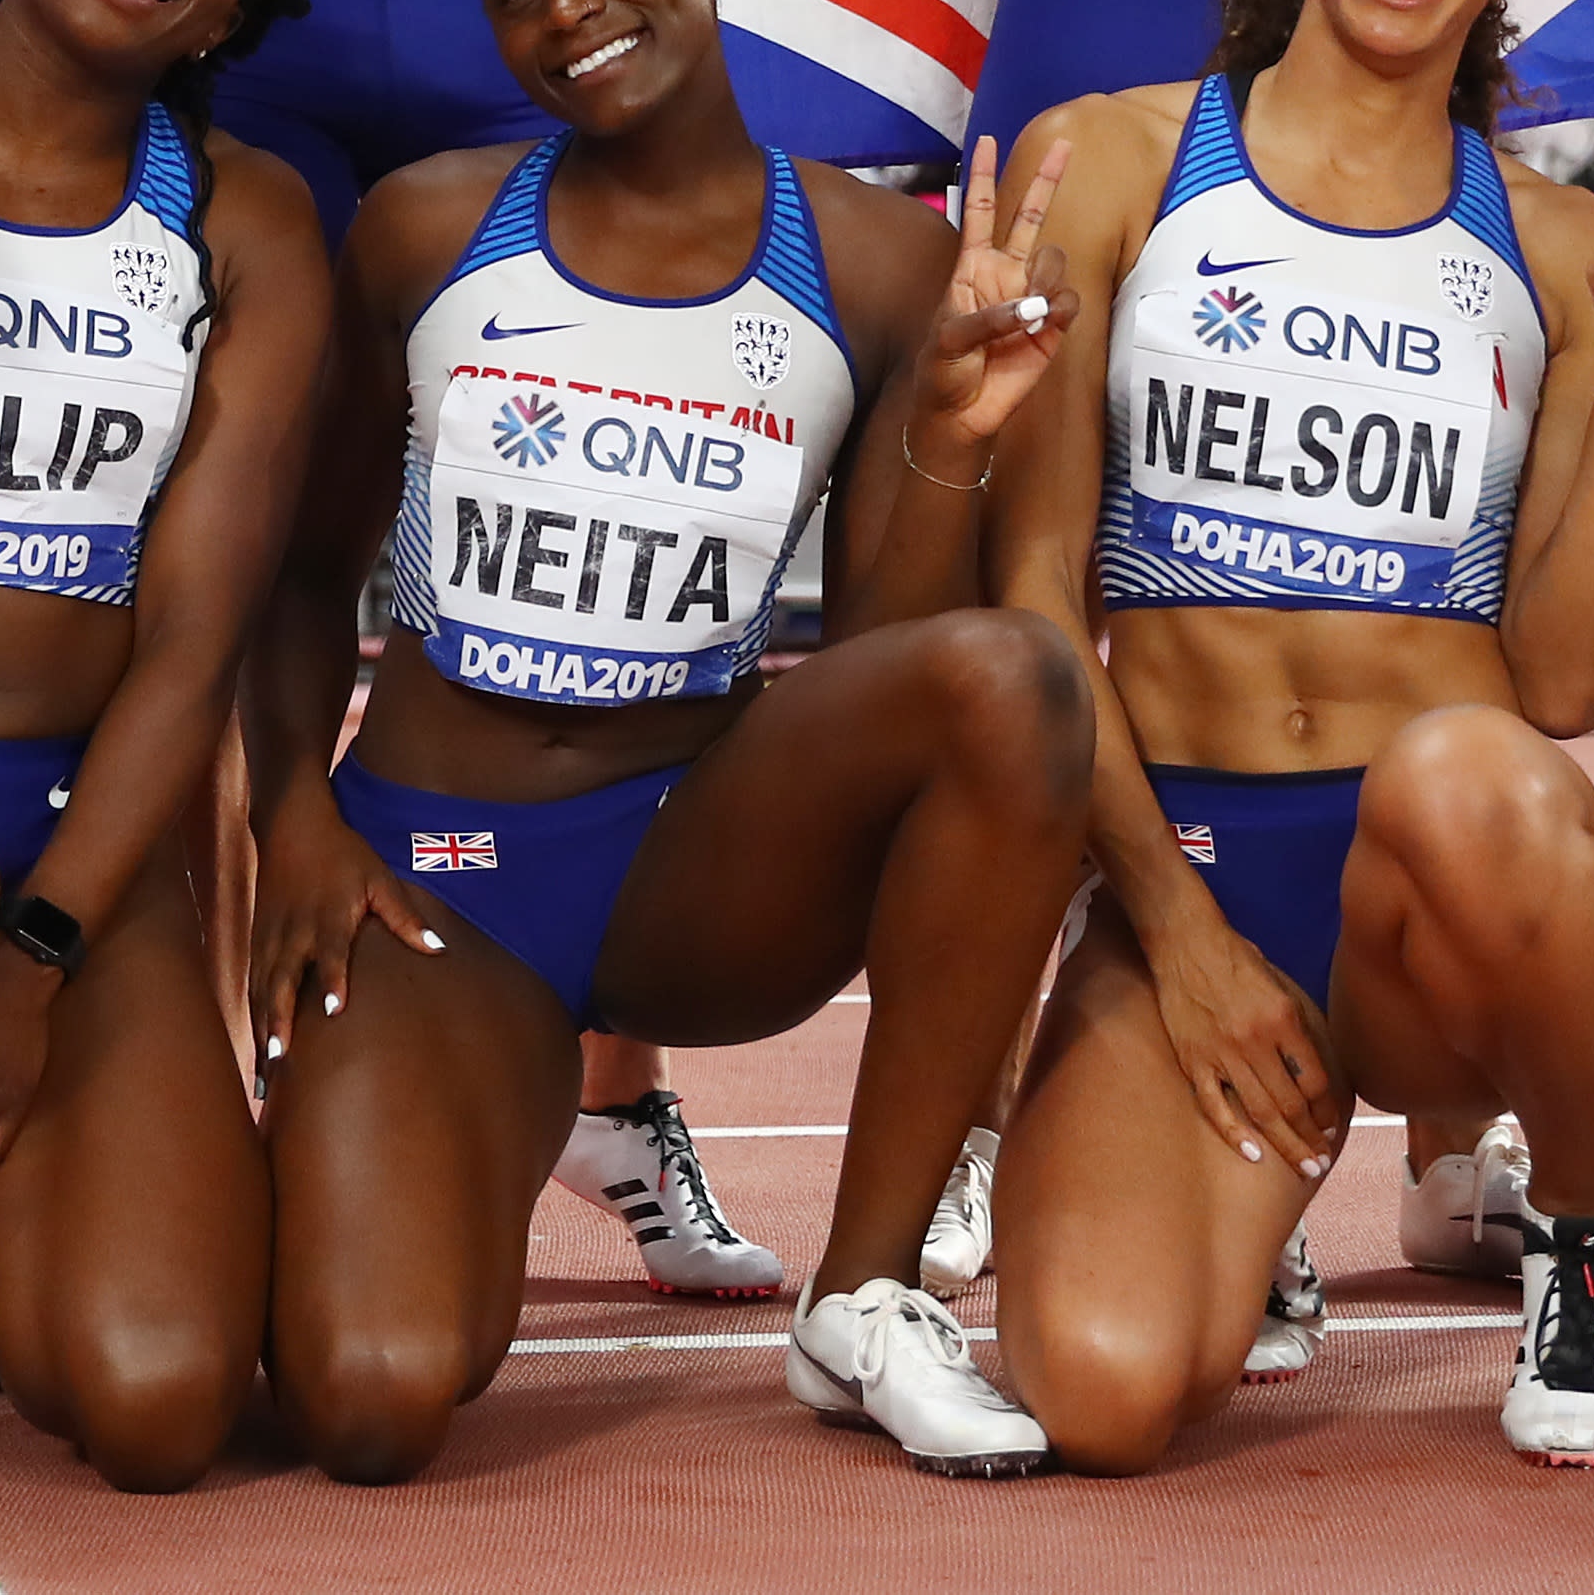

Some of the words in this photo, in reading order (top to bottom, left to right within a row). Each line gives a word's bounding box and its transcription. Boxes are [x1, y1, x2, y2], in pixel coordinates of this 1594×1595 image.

[1283, 306, 1443, 376] QNB
[582, 417, 746, 492] QNB
[1144, 377, 1461, 521] NELSON
[449, 496, 730, 623] NEITA
[1171, 511, 1406, 593] DOHA2019
[459, 633, 690, 699] DOHA2019
